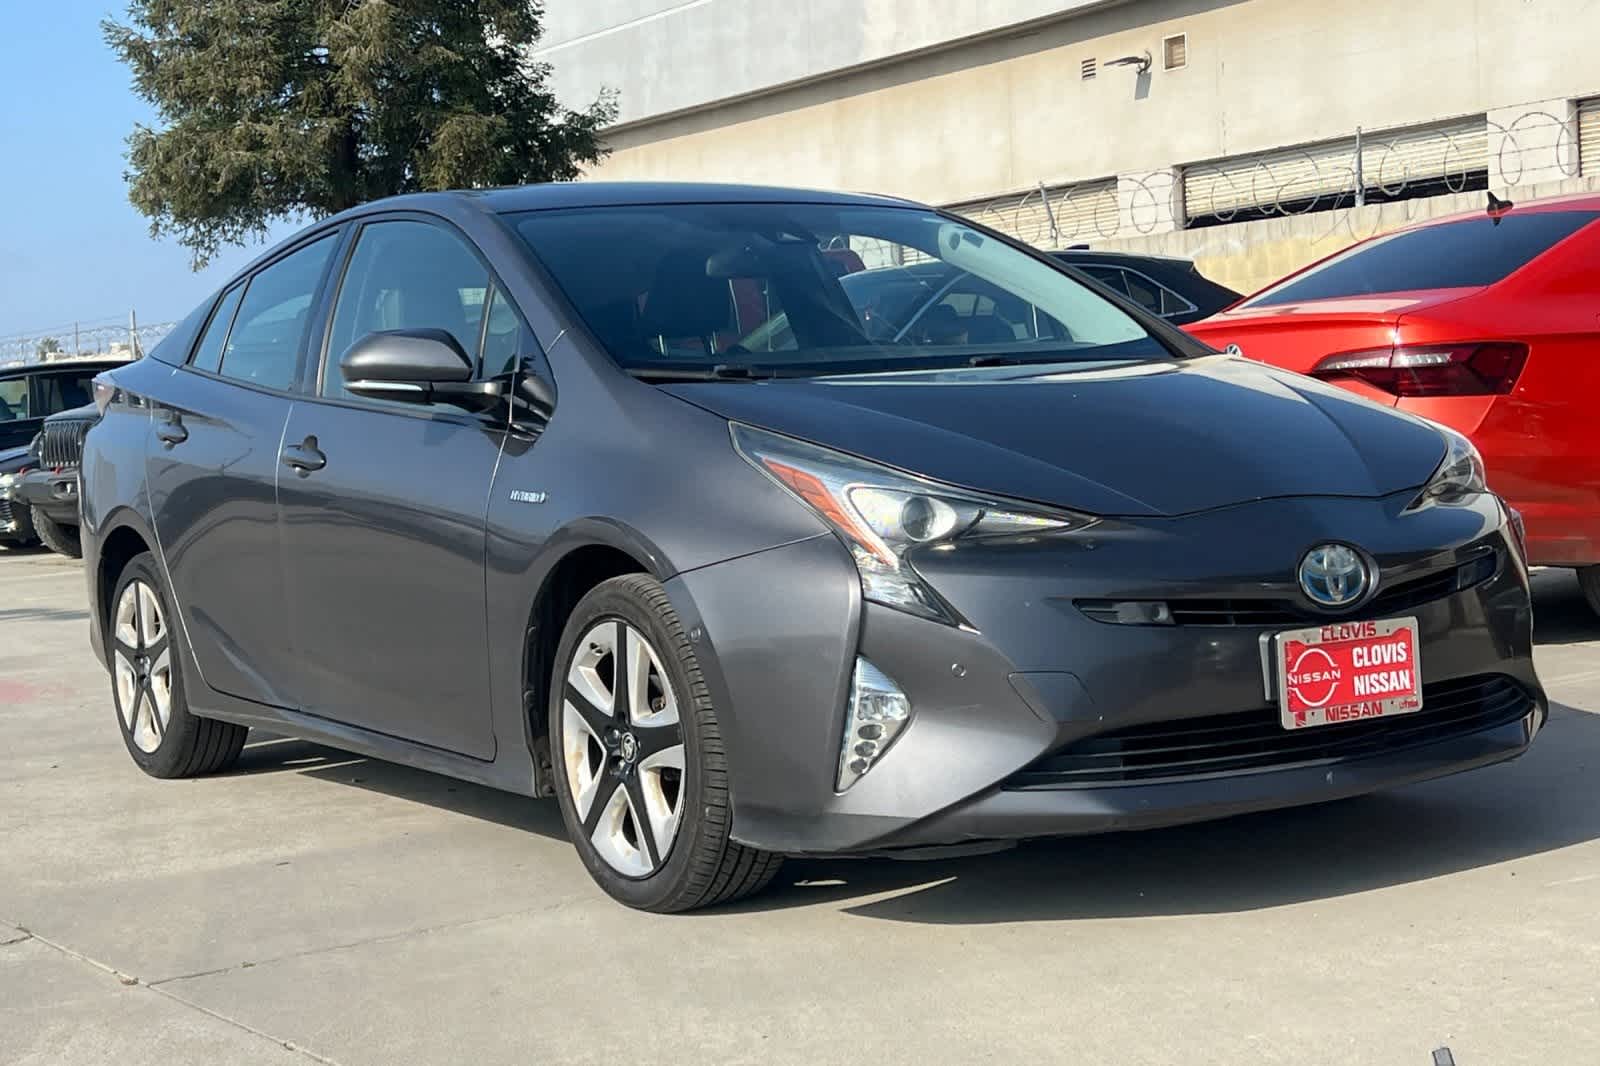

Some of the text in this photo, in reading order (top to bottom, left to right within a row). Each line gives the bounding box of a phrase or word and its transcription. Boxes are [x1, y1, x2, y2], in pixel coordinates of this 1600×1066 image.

[1321, 621, 1376, 642] CLOVIS
[1352, 642, 1408, 668] CLOVIS
[1288, 669, 1341, 685] NISSAN
[1354, 670, 1411, 696] NISSAN
[1325, 702, 1383, 722] NISSAN
